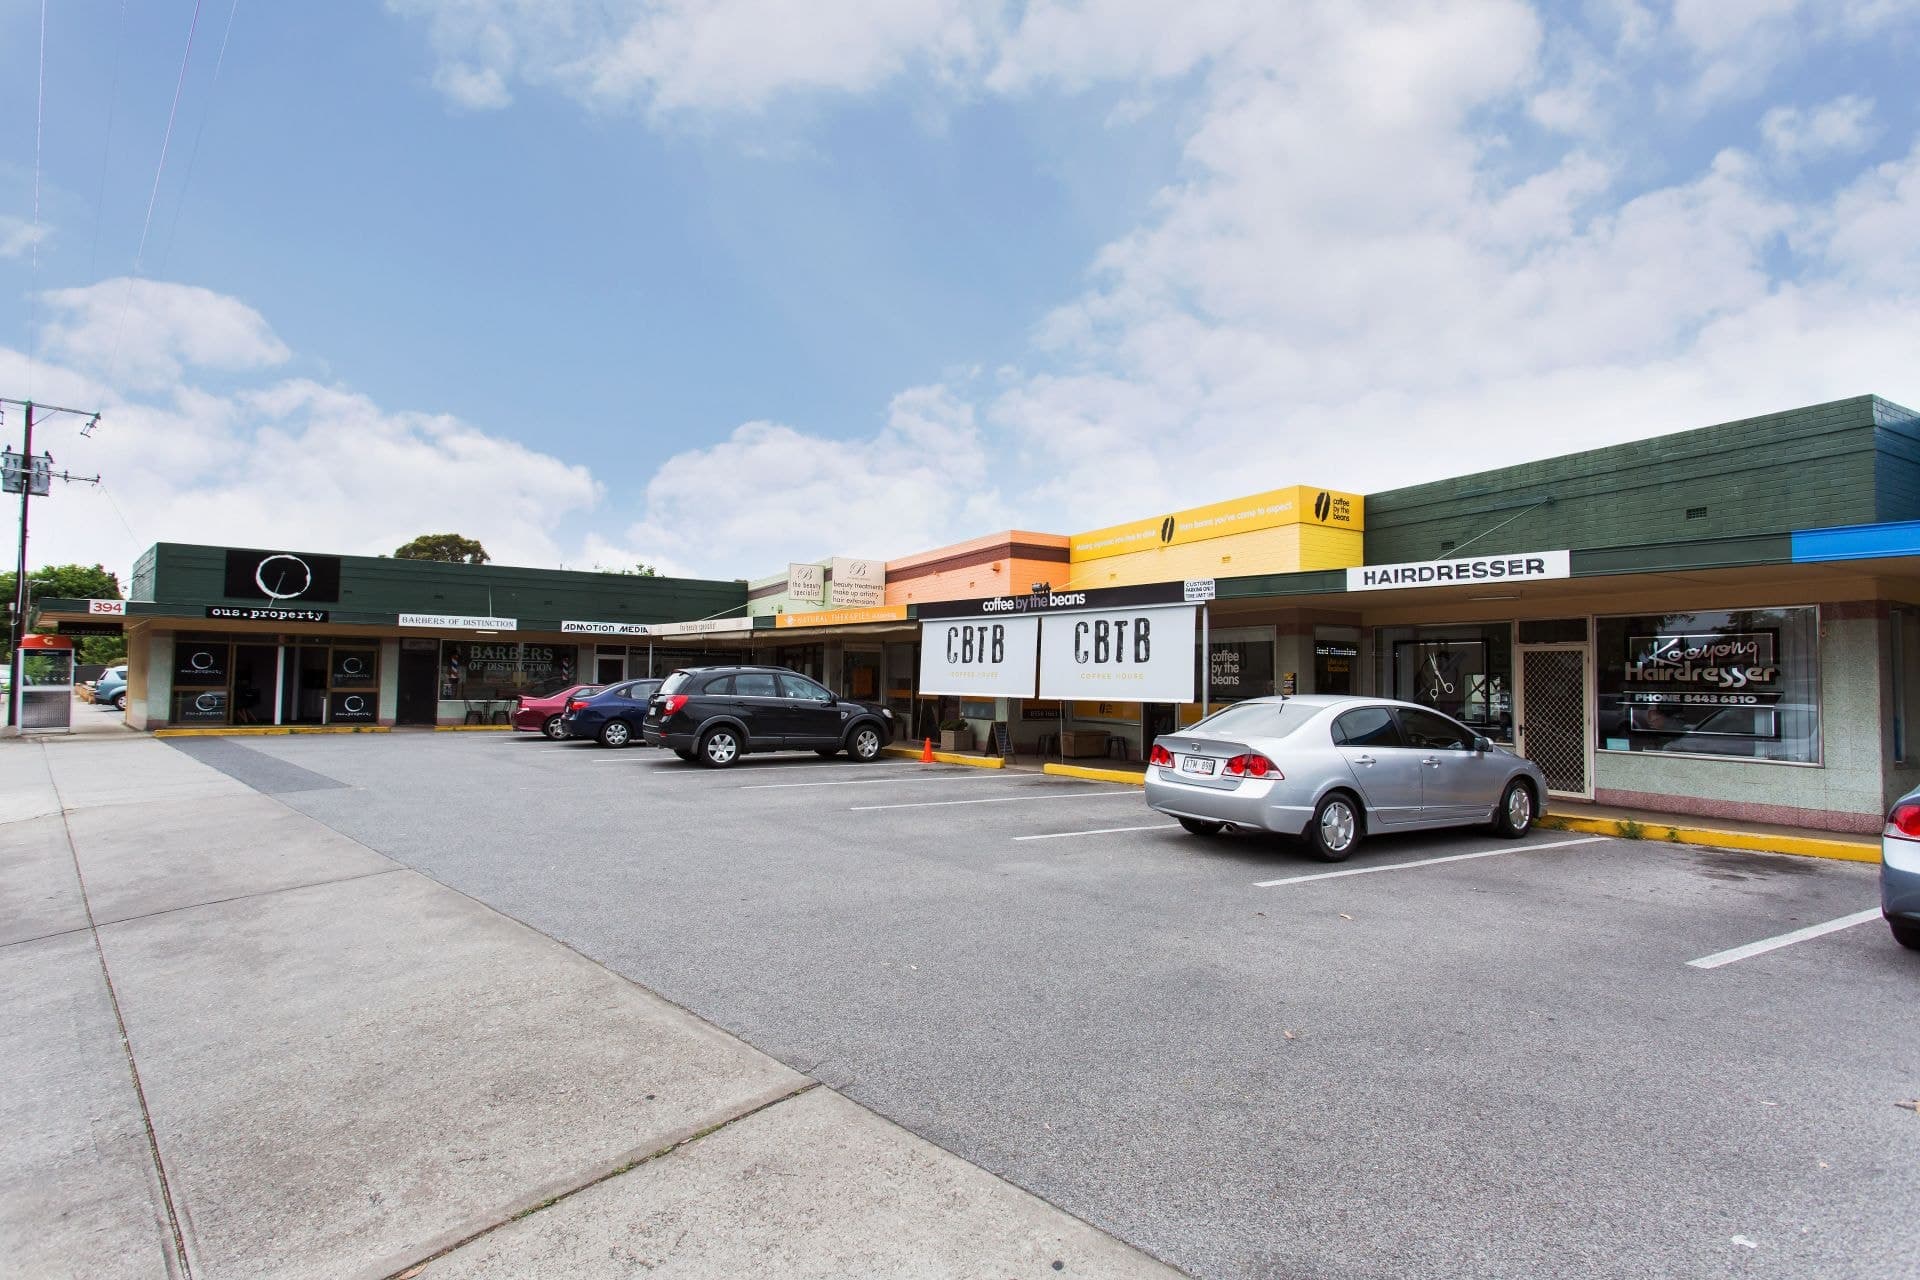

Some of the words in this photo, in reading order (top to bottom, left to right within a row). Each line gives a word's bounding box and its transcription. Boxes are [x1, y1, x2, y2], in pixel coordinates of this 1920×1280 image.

[1333, 498, 1350, 507] coffee
[1333, 505, 1340, 514] by
[1340, 506, 1350, 514] the
[1333, 513, 1350, 521] beans
[1363, 558, 1545, 585] HAIRDRESSER
[792, 580, 801, 588] the
[803, 581, 821, 591] beauty
[833, 579, 853, 589] beauty
[854, 581, 883, 591] treatments
[793, 589, 820, 597] specialist
[833, 588, 849, 596] make
[832, 595, 845, 603] hair
[846, 597, 876, 605] extensions
[982, 597, 1014, 611] coffee
[1015, 595, 1029, 613] by
[1030, 594, 1048, 608] the
[1050, 591, 1086, 607] beans
[93, 602, 122, 613] 394
[212, 608, 324, 621] ous.property
[402, 616, 445, 625] BARBERS
[463, 619, 514, 628] DISTINCTION
[563, 623, 615, 632] ADMOTION
[619, 625, 649, 634] MEDIA
[946, 624, 1005, 664] CBTB
[1074, 618, 1151, 664] CBTB
[470, 645, 553, 660] BARBERS
[1211, 650, 1240, 662] coffee
[1649, 638, 1758, 667] Kooyong
[468, 662, 484, 671] OF
[487, 662, 553, 672] DISTINCTION
[1211, 662, 1222, 676] by
[1223, 662, 1240, 673] the
[1080, 672, 1112, 680] COFFEE
[1115, 672, 1144, 680] HOUSE
[1211, 674, 1240, 685] beans
[1624, 661, 1775, 688] Hairdresser
[1635, 693, 1681, 702] PHONE
[1684, 694, 1718, 703] 8443
[1720, 694, 1757, 704] 6810
